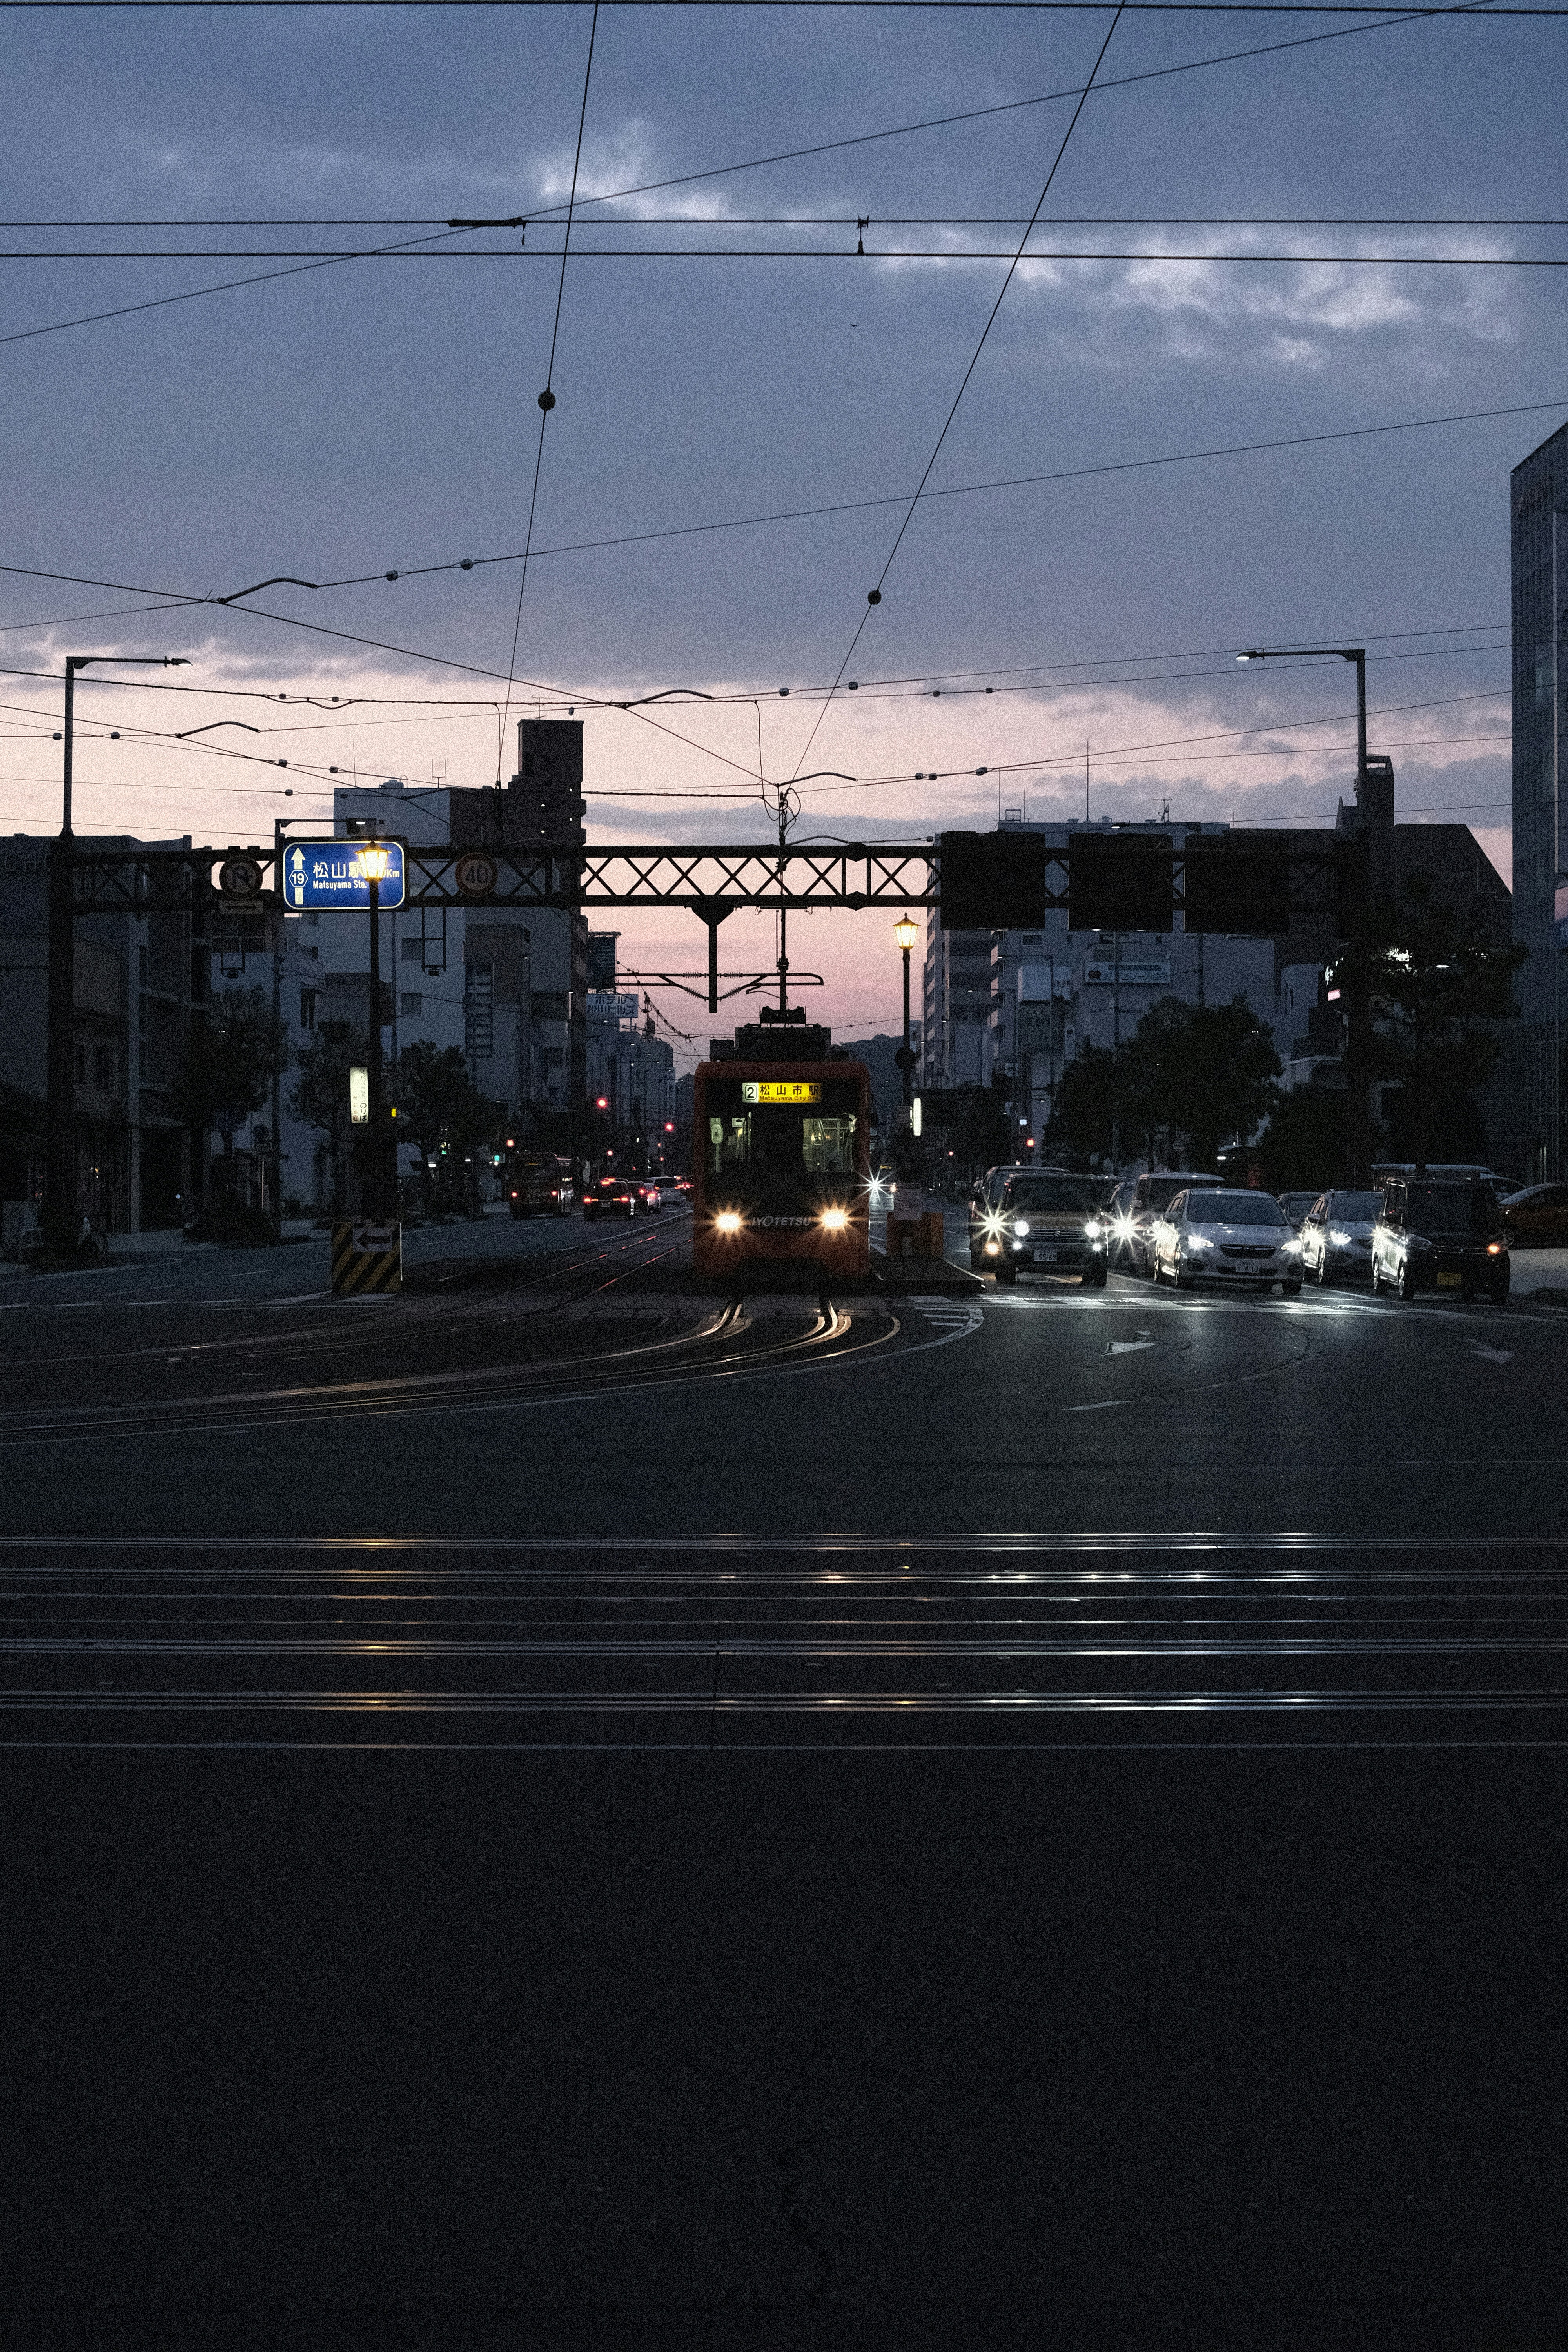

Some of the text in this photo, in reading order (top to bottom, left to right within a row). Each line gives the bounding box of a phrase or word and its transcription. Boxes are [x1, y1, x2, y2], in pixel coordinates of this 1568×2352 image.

[292, 873, 305, 884] 19
[465, 866, 488, 884] 40
[313, 880, 367, 891] Matsuyama Sta.
[747, 1085, 819, 1098] 2 松山市駅
